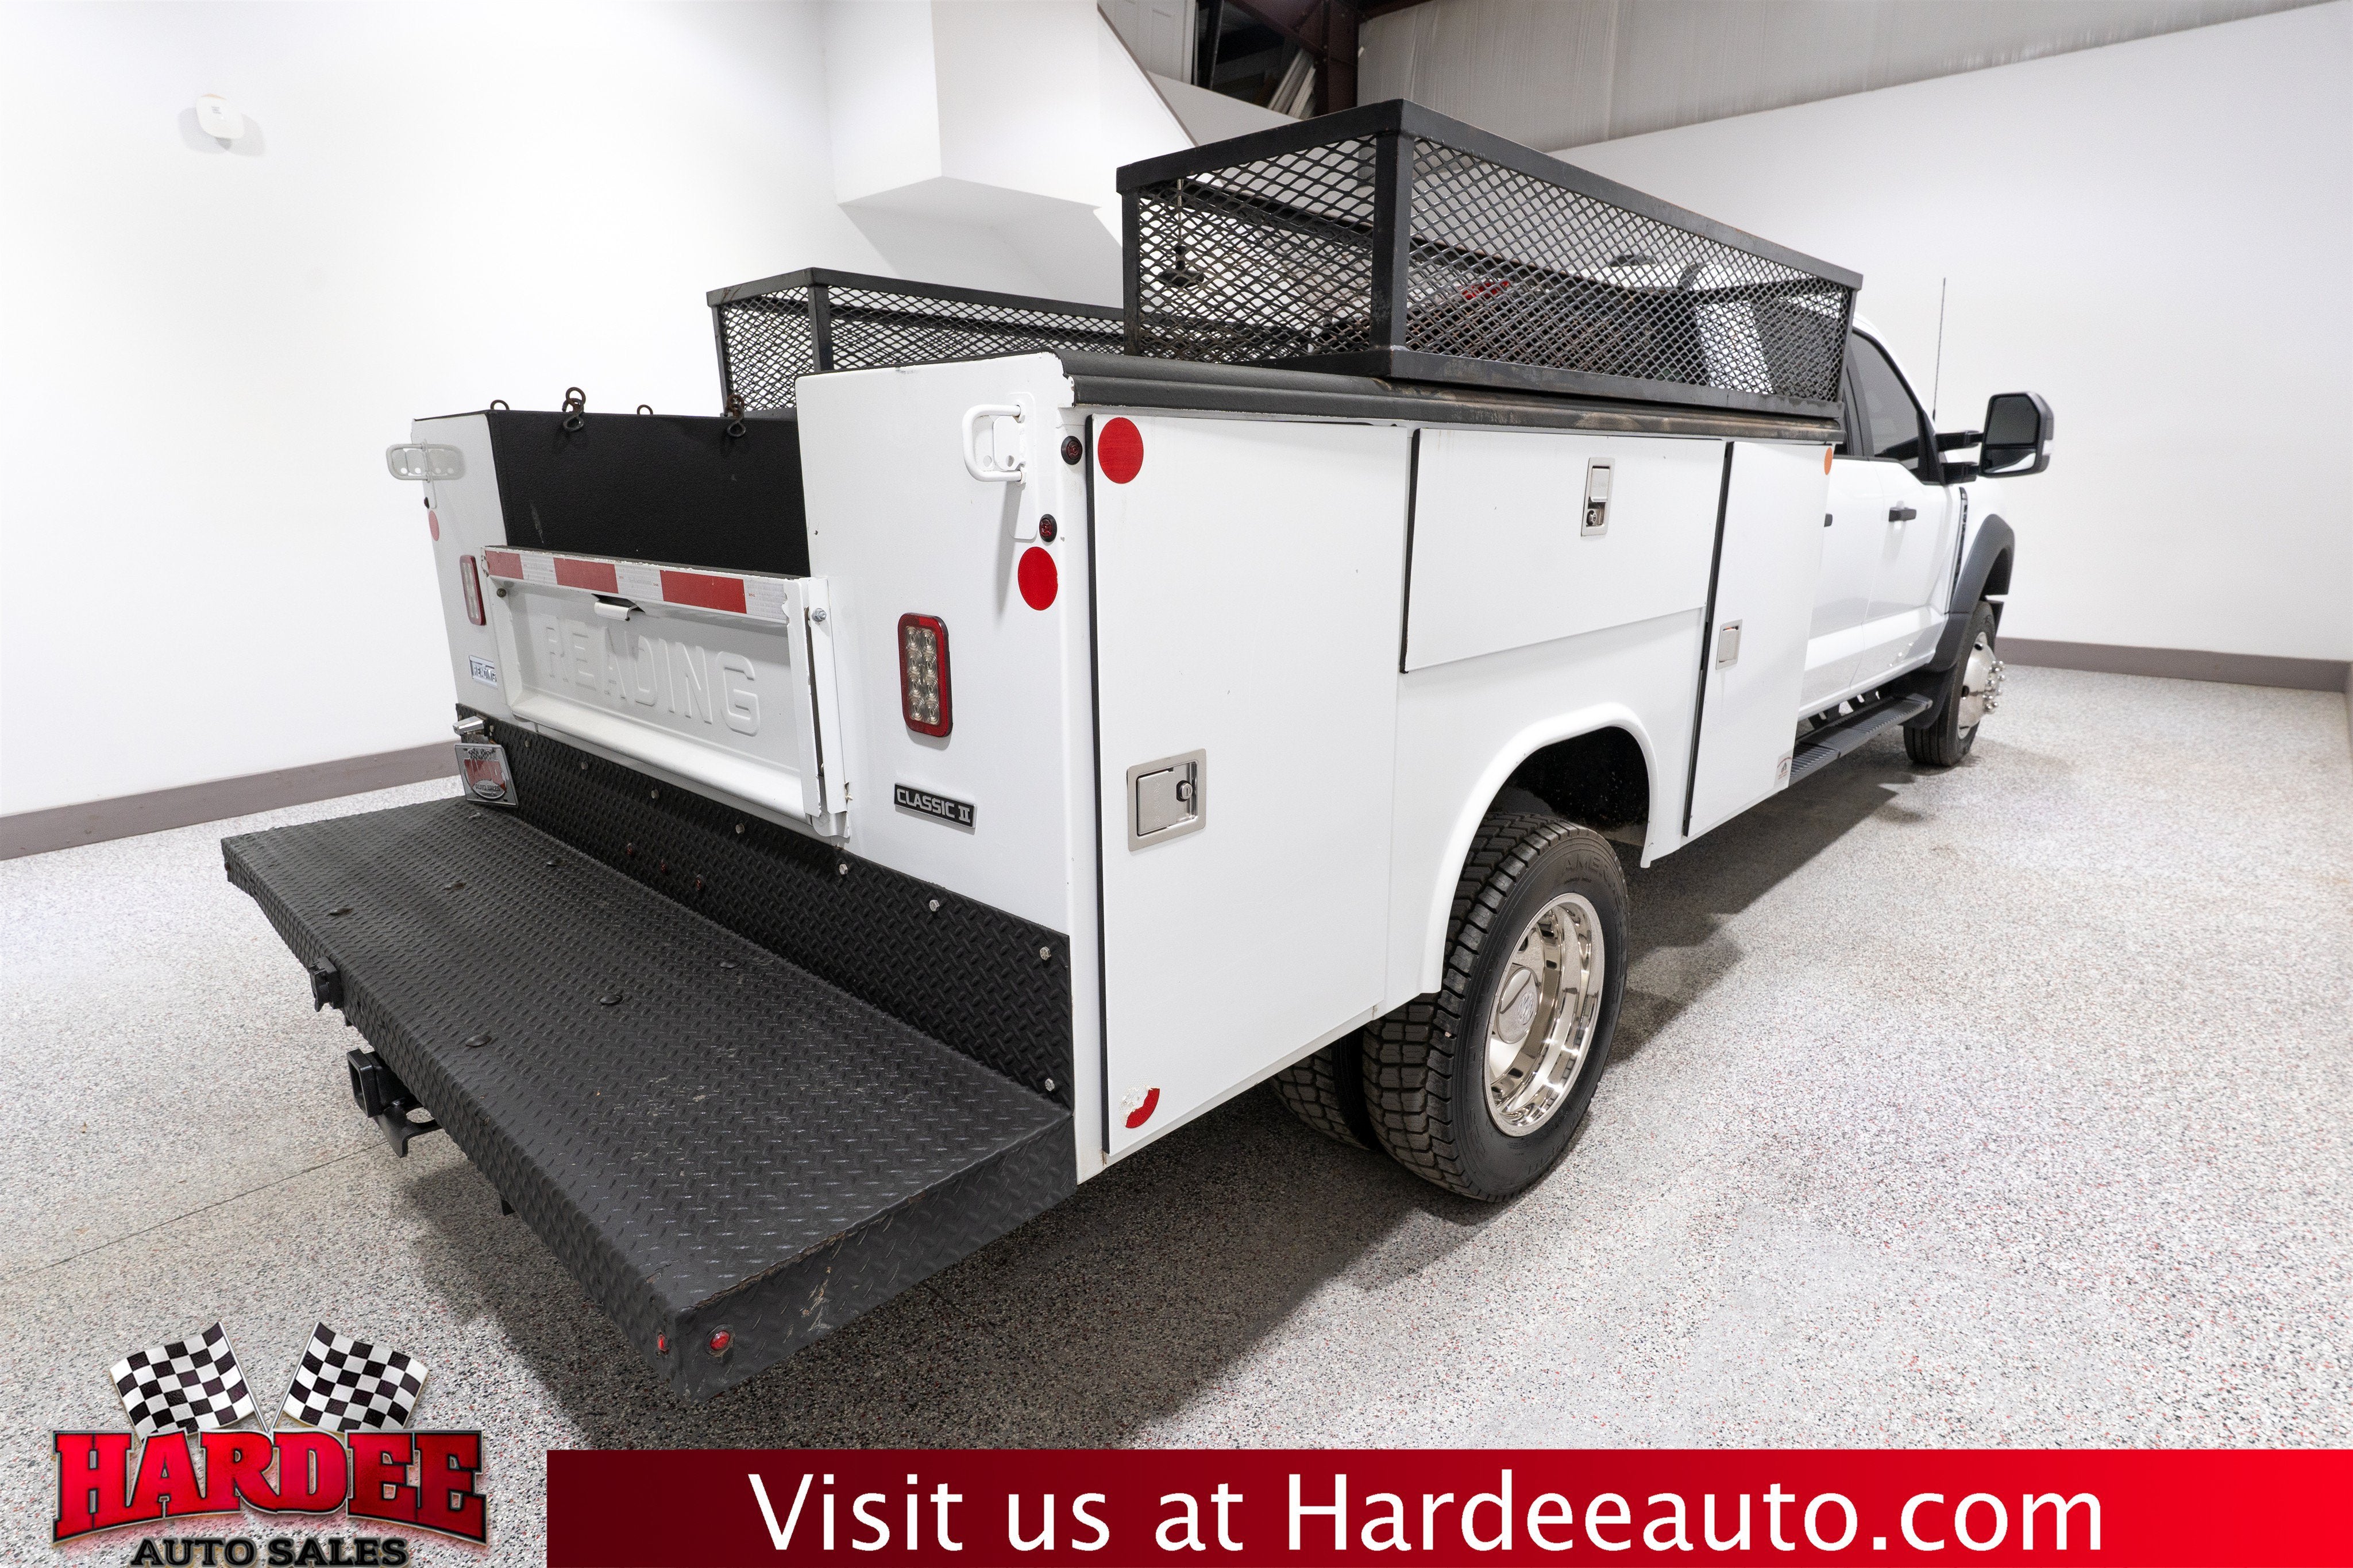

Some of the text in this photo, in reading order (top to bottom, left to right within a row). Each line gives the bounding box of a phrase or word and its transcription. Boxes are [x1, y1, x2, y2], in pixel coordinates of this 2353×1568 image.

[541, 613, 761, 736] READING
[897, 788, 971, 823] CLASSIC II
